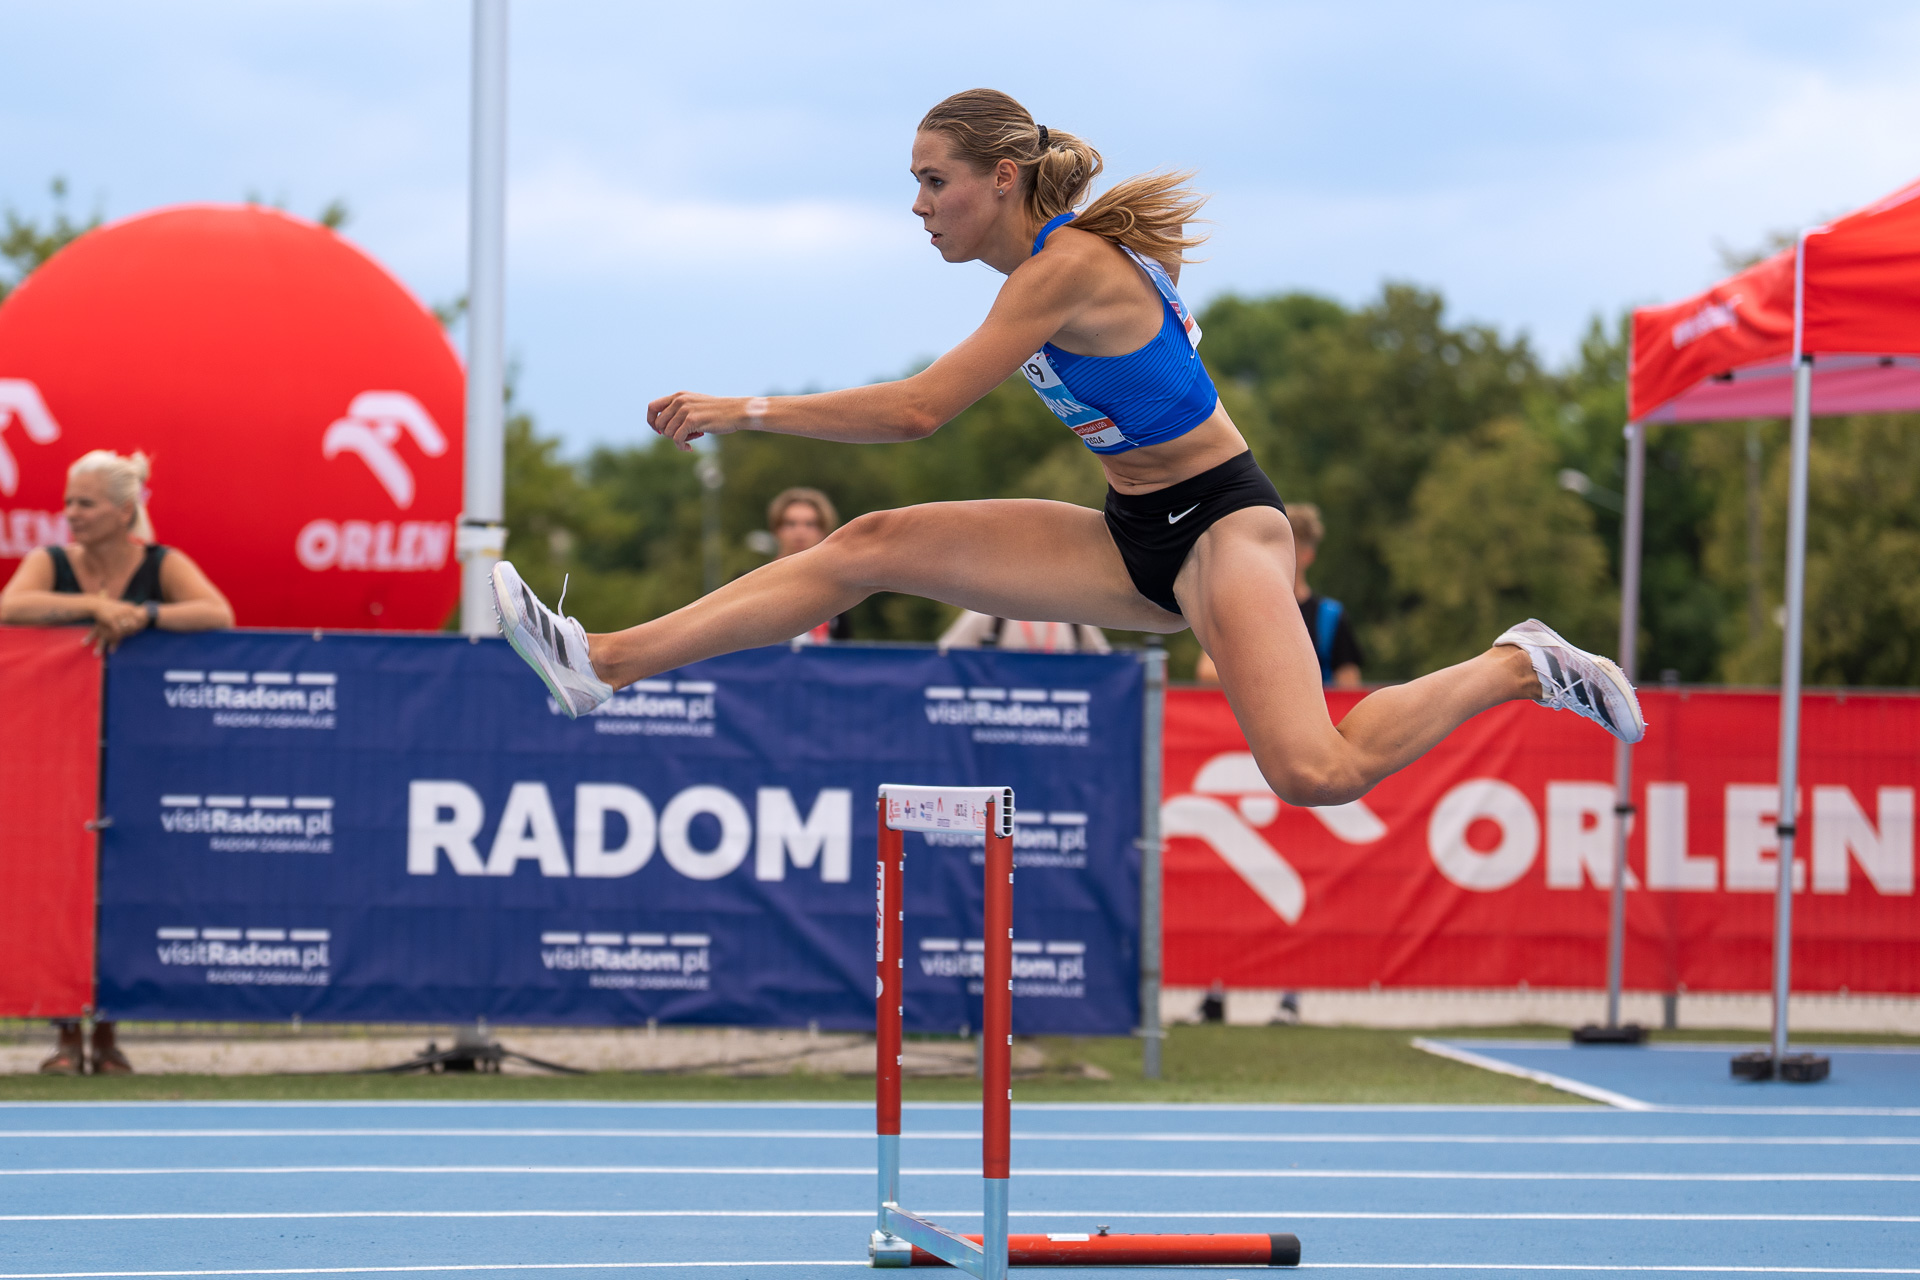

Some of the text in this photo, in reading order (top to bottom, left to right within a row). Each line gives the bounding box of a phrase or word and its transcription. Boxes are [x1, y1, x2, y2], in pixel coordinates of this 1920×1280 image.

[297, 519, 452, 572] ORLEN
[164, 684, 336, 715] visitRadom.pl
[925, 701, 1090, 732] visitRadom.pl
[161, 808, 334, 839] visitRadom.pl
[407, 780, 852, 883] RADOM
[1427, 778, 1915, 896] ORLEN
[157, 941, 330, 971] visitRadom.pl
[541, 946, 711, 976] visitRadom.pl
